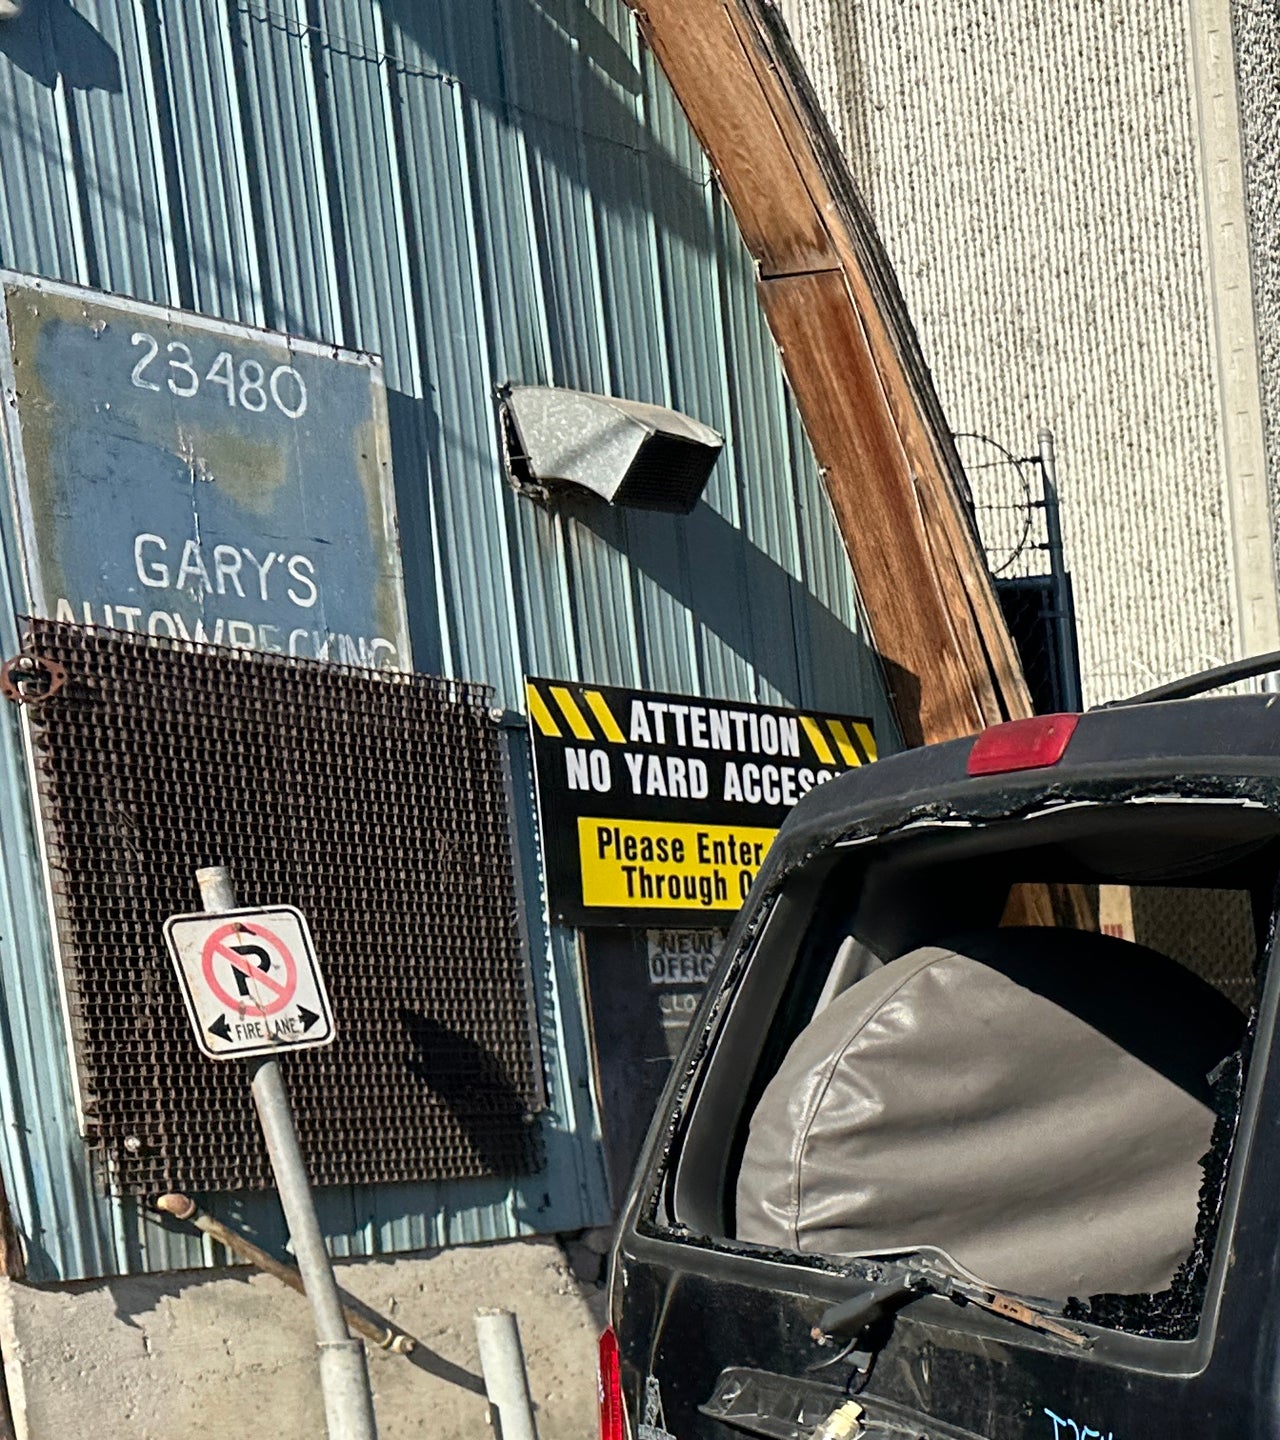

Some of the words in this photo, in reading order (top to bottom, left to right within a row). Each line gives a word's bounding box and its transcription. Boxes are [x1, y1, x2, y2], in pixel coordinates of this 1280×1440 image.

[131, 332, 307, 419] 23480
[134, 533, 318, 608] GARY'S
[629, 699, 801, 758] ATTENTION
[565, 746, 612, 793] NO
[624, 752, 709, 800] YARD
[597, 826, 685, 863] Please
[696, 832, 763, 867] Enter
[621, 865, 728, 907] Through
[652, 956, 716, 978] OFFIC
[235, 1021, 265, 1041] FIRE
